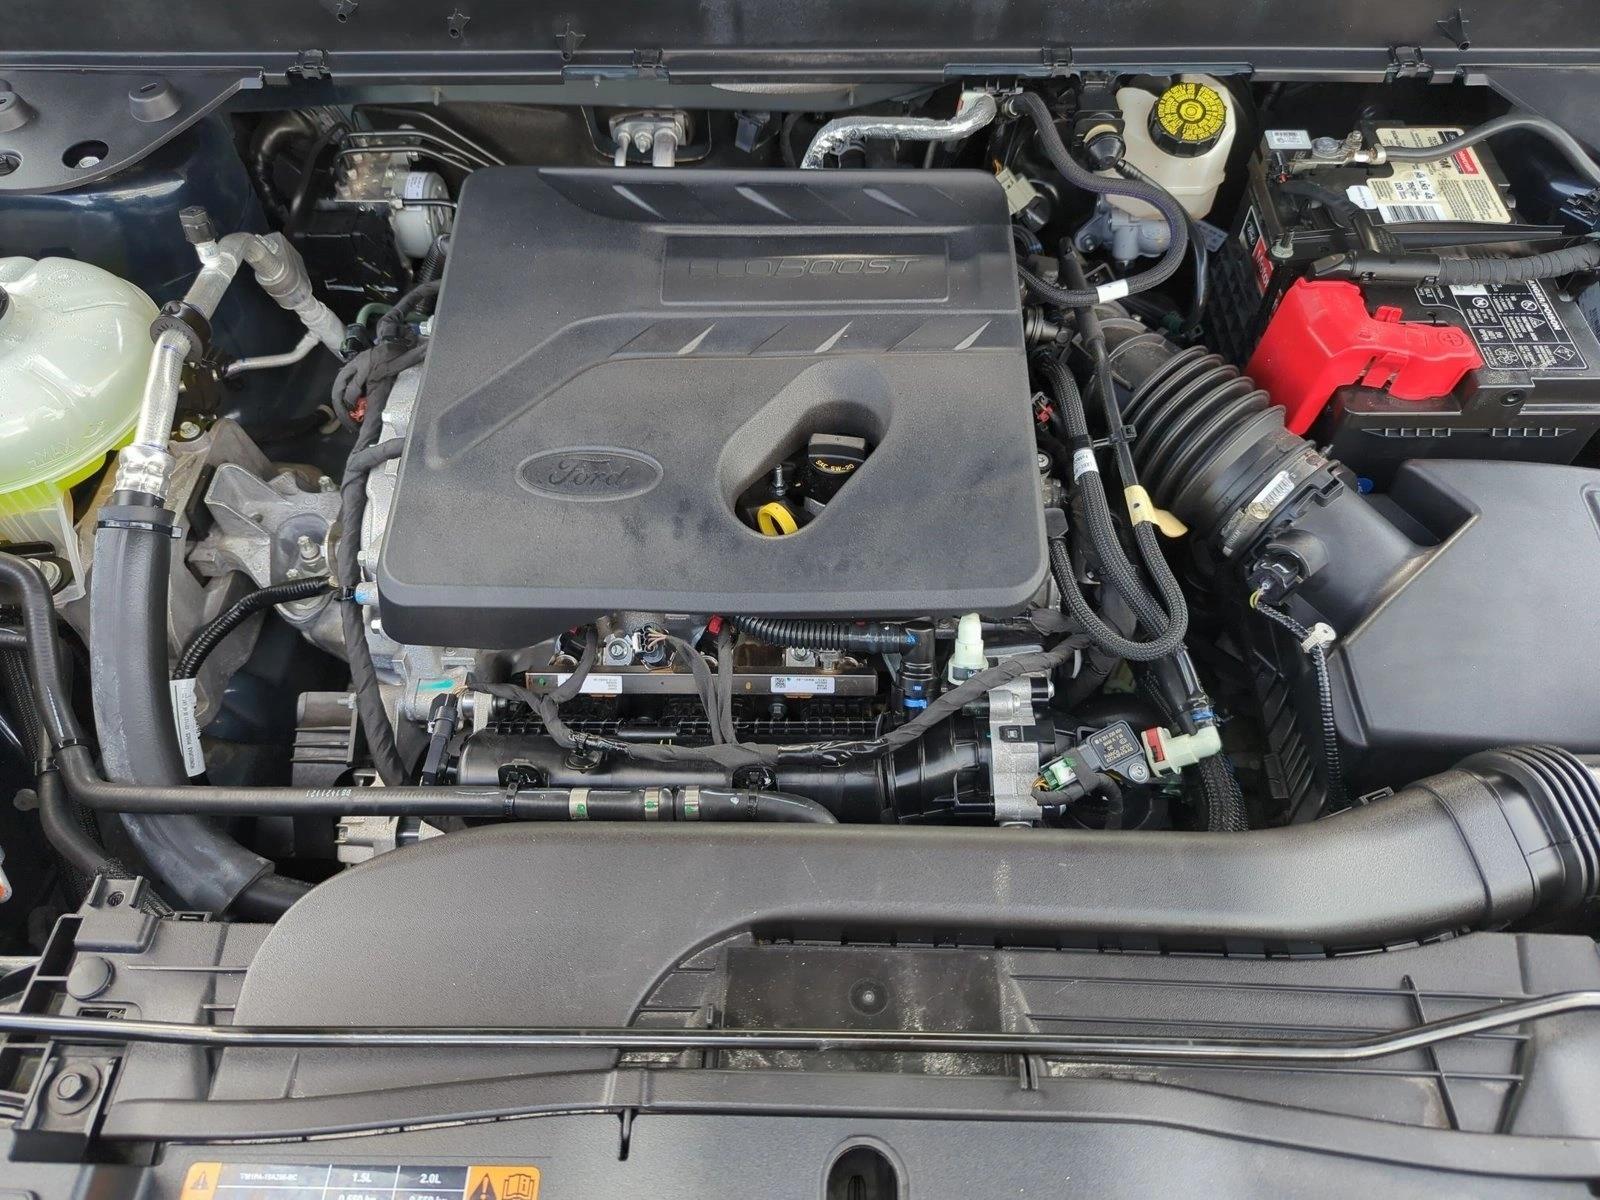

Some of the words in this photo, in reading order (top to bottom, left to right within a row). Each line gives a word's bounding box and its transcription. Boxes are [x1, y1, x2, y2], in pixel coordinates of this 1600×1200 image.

[1528, 280, 1561, 330] ANGER/POISON
[352, 1172, 372, 1183] 1.5L
[419, 1173, 442, 1184] 2.0L
